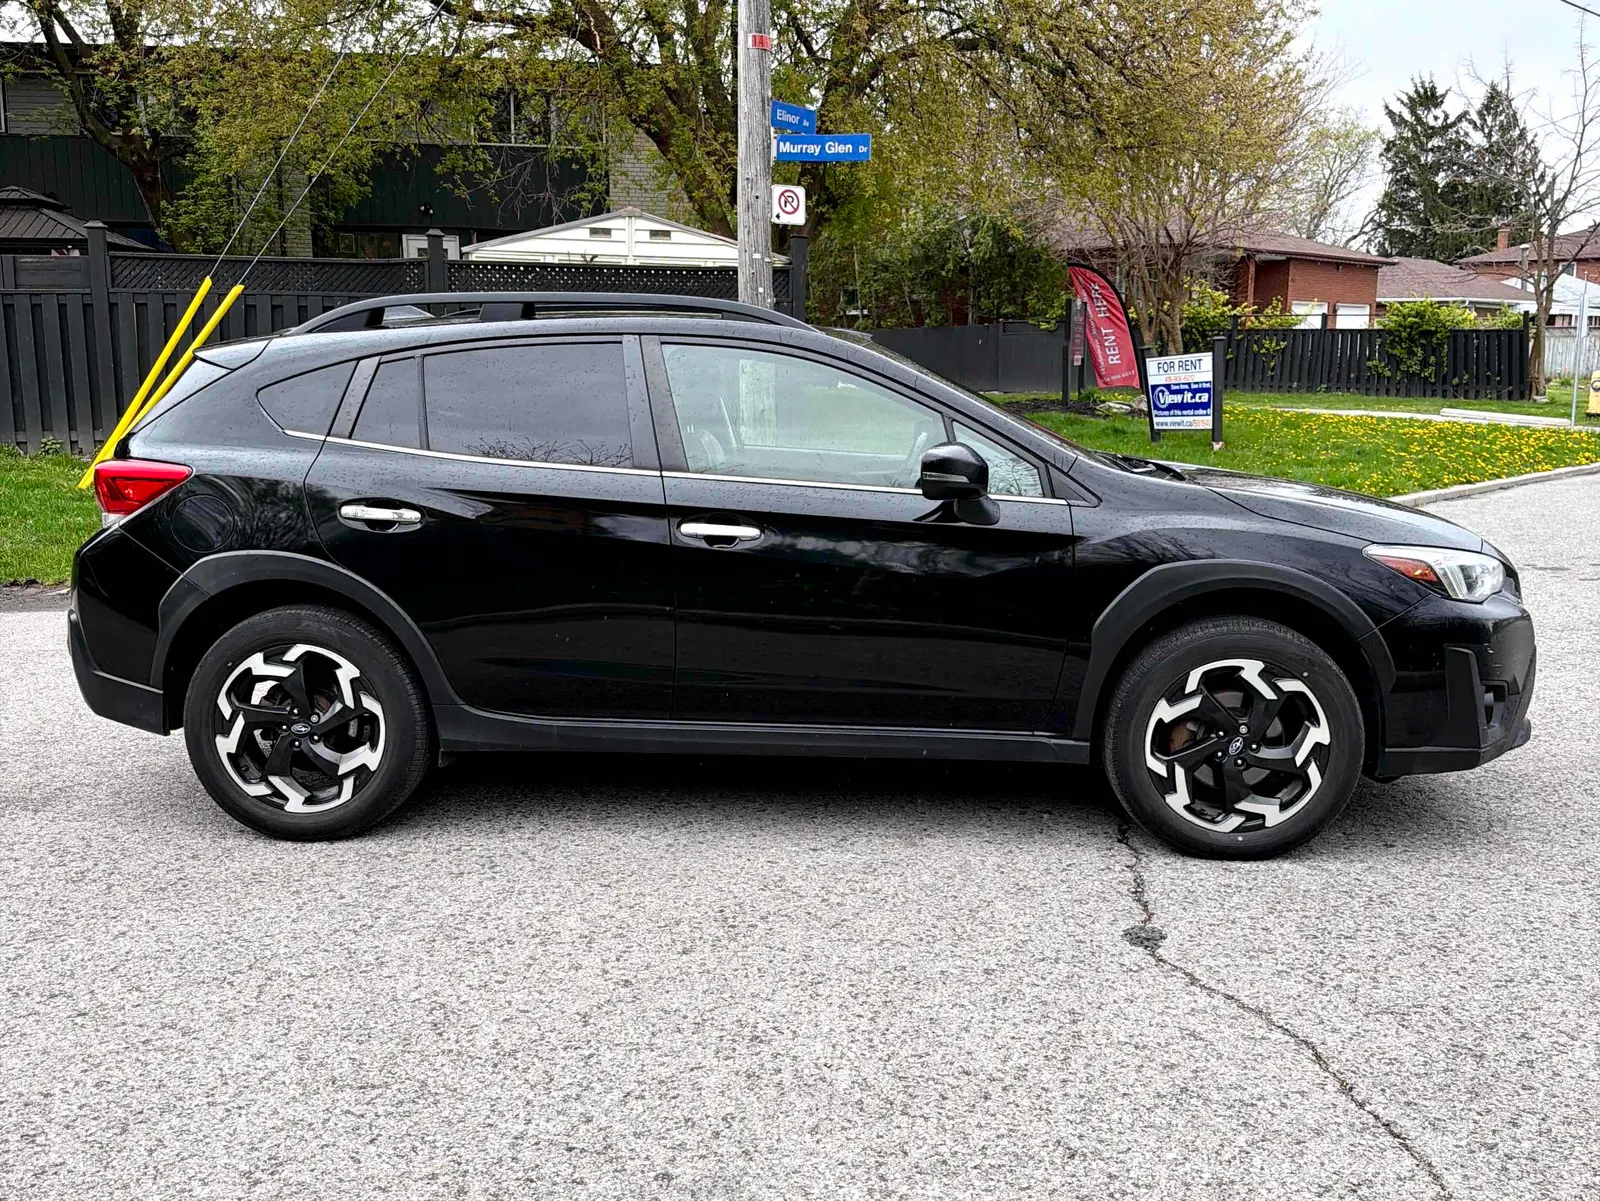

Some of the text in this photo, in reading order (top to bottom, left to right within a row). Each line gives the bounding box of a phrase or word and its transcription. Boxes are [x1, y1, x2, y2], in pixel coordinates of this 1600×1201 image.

[776, 108, 810, 127] Elinor Av
[779, 141, 868, 156] Murray Glen Dr
[1101, 328, 1121, 364] RENT
[1157, 358, 1203, 374] FOR RENT
